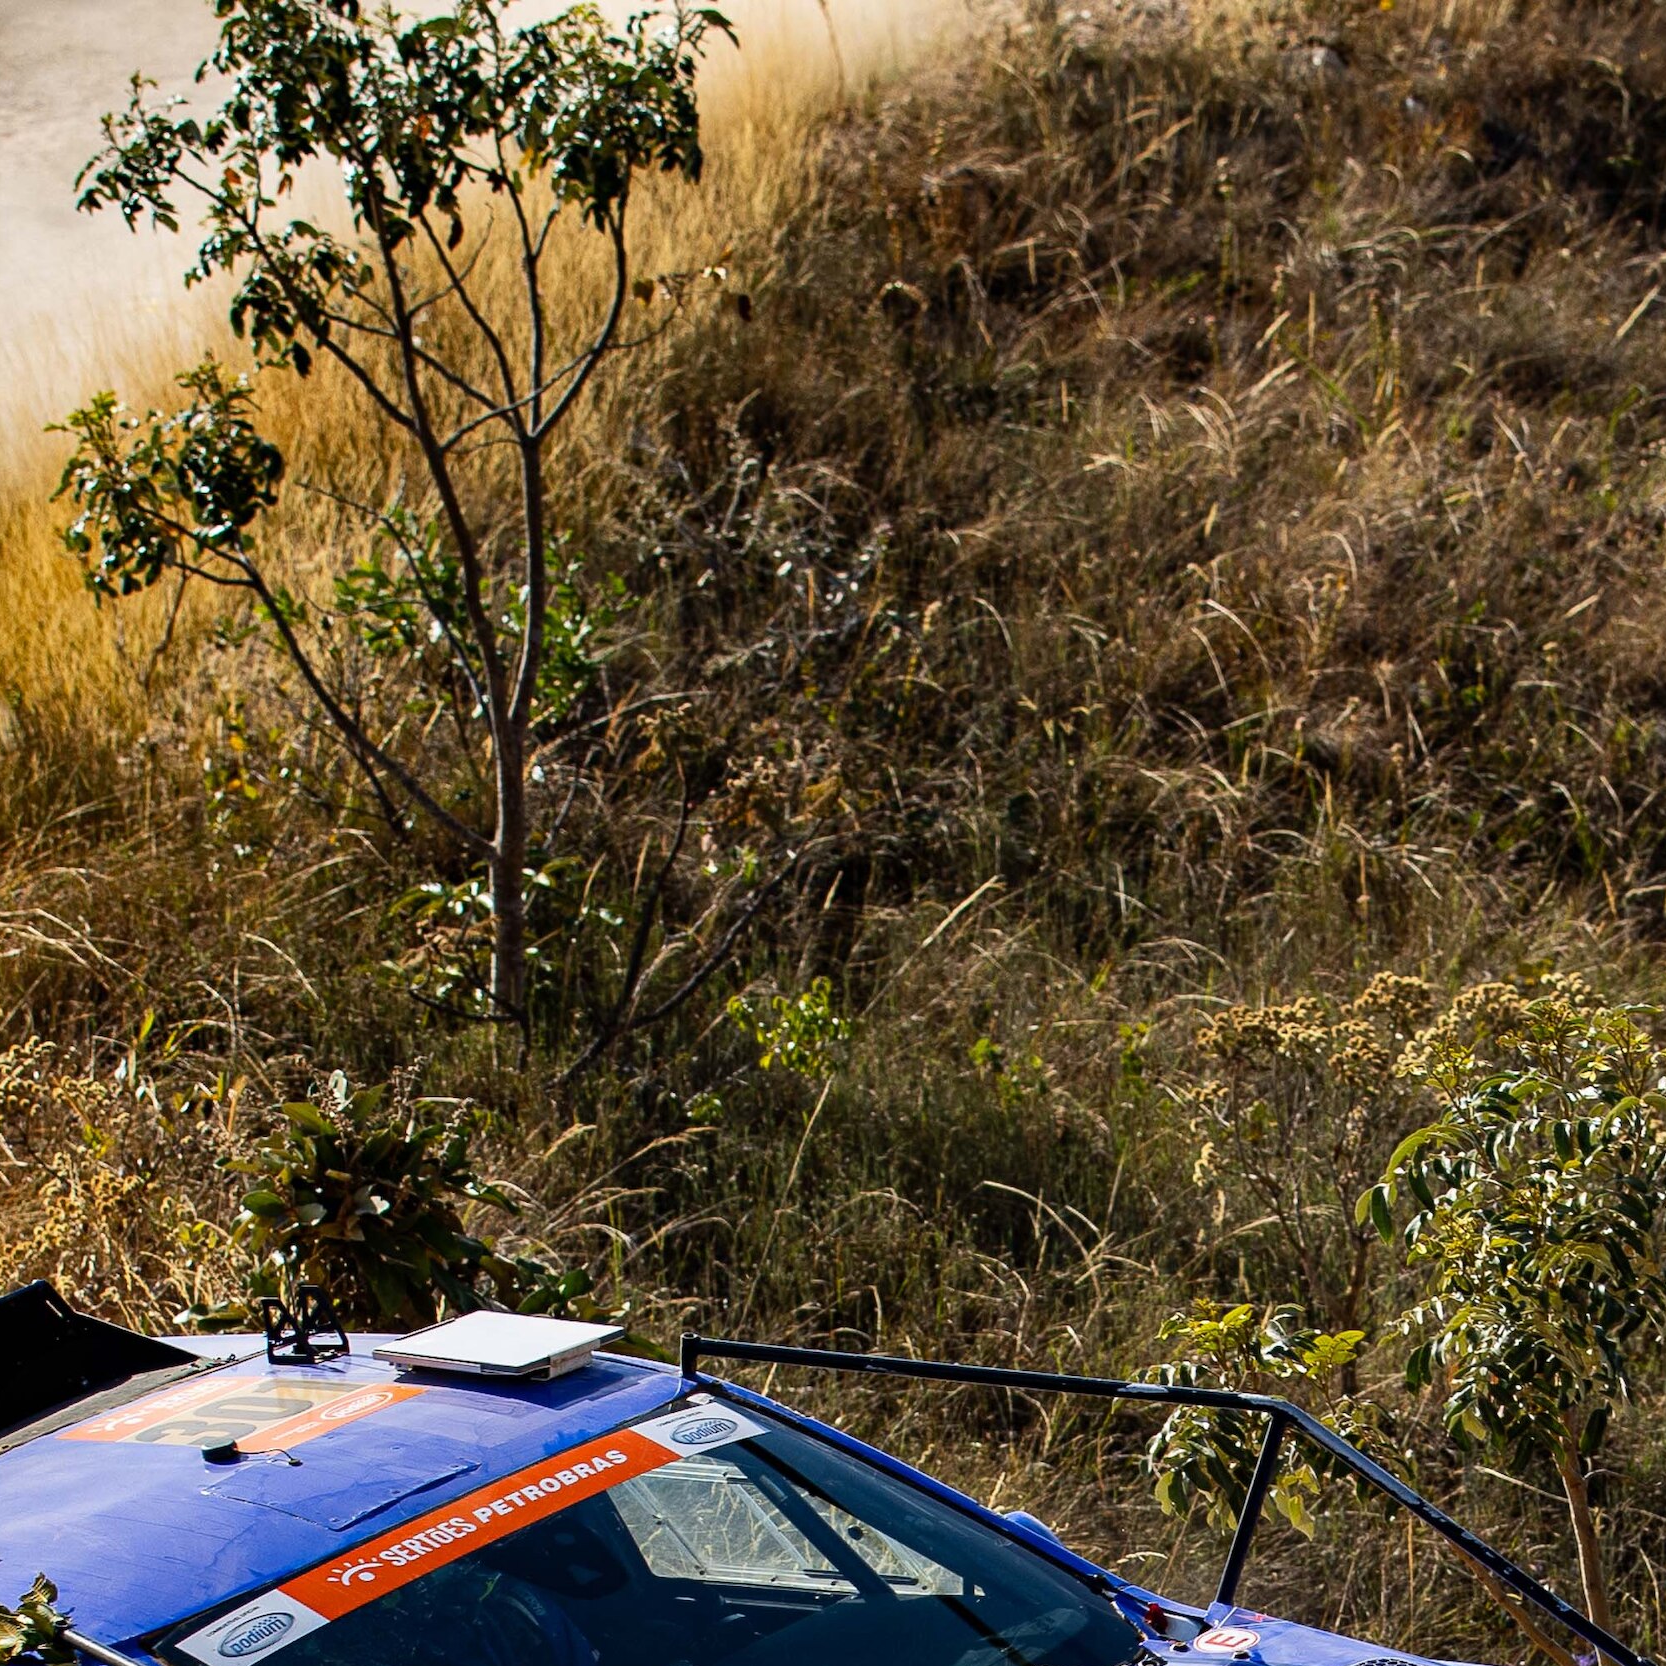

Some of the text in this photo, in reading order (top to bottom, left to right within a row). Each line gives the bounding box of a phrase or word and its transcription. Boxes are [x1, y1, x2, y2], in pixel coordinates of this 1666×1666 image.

[681, 1421, 731, 1444] podium
[472, 1449, 628, 1524] PETROBRAS
[228, 1617, 288, 1655] podium
